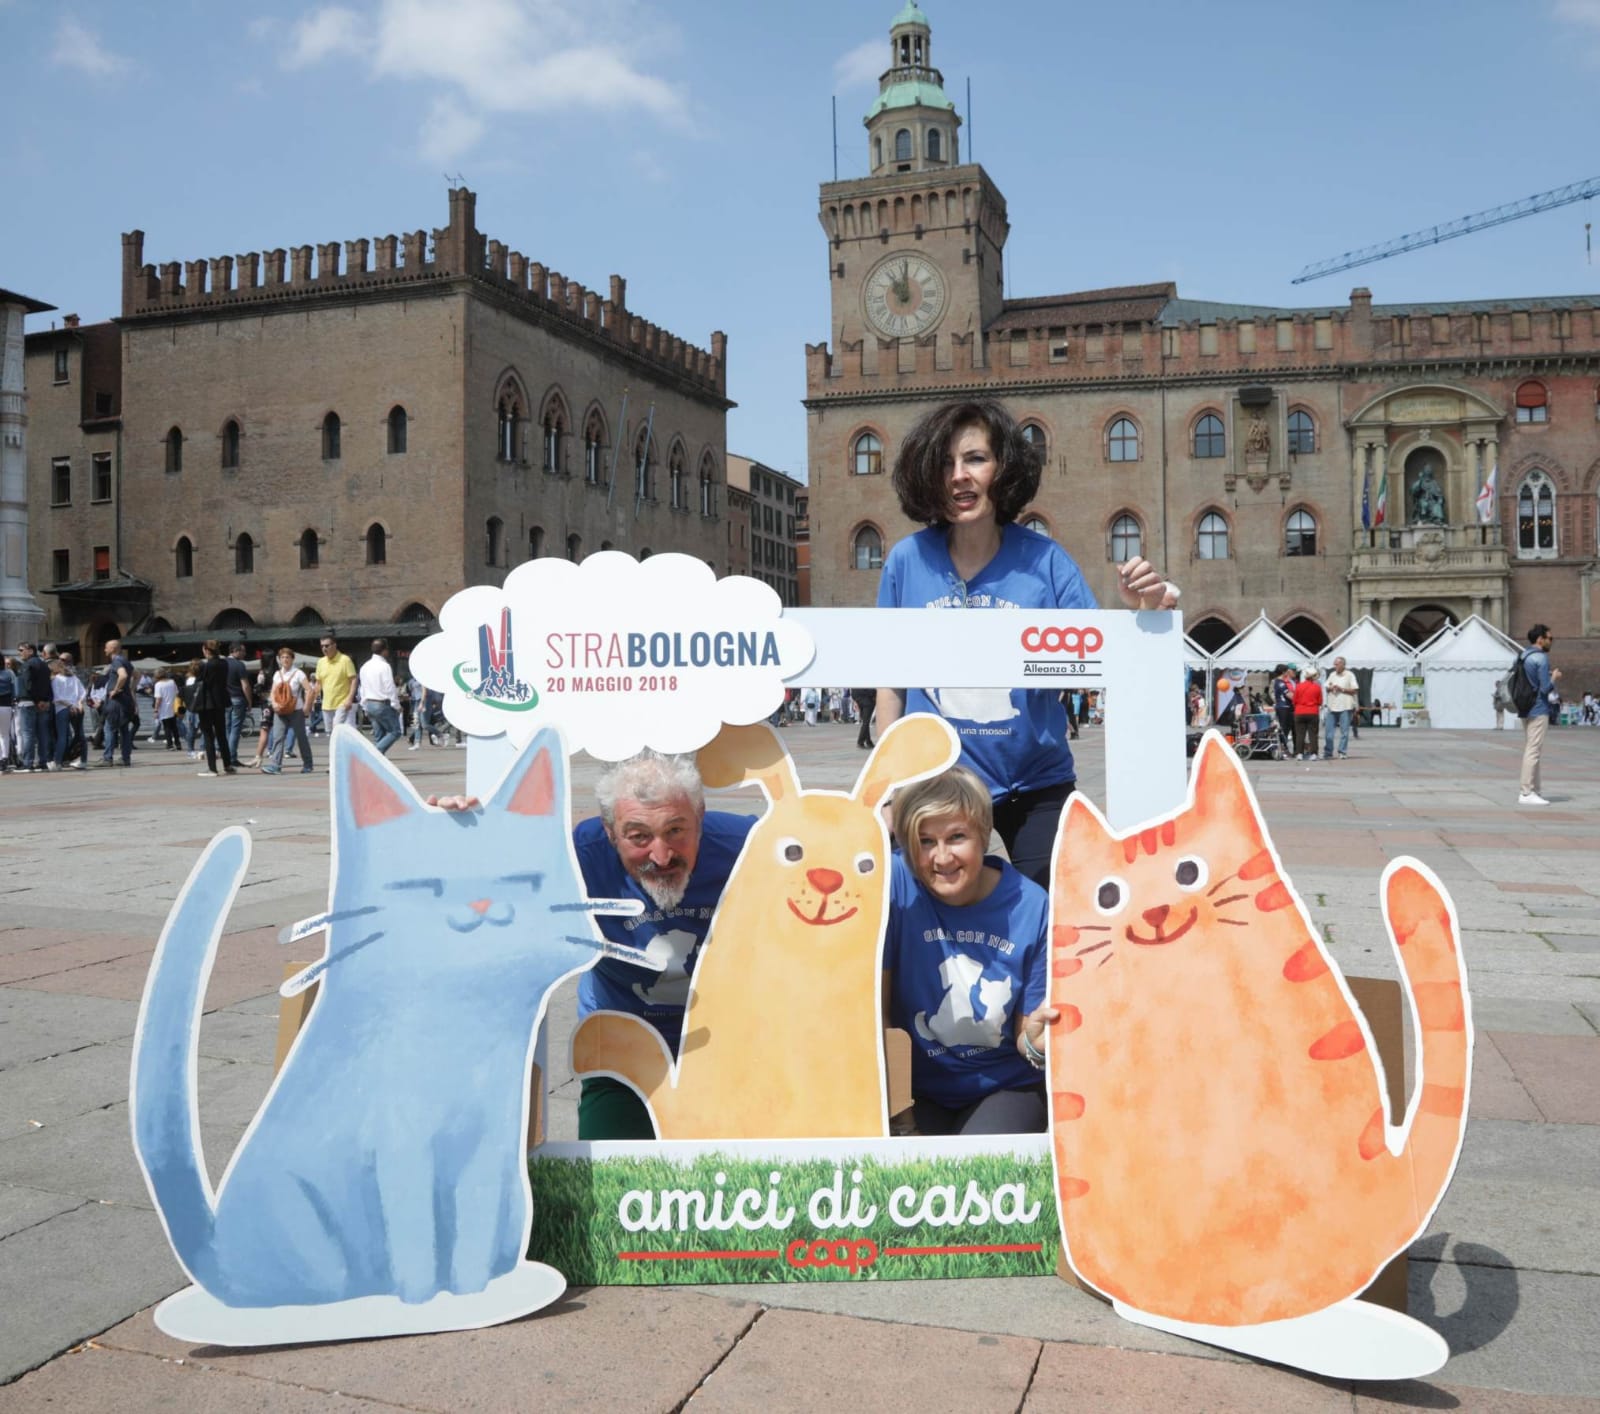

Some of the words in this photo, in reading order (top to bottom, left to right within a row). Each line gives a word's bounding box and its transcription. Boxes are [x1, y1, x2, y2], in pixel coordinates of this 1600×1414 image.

[965, 594, 992, 607] CON
[545, 630, 782, 669] STRABOLOGNA
[1021, 627, 1103, 659] coop
[1023, 664, 1067, 673] Alleanza
[1070, 664, 1086, 673] 3.0
[546, 676, 565, 692] 20
[571, 676, 633, 692] MAGGIO
[639, 675, 678, 692] 2018
[979, 727, 1012, 736] mossa!
[956, 930, 985, 944] CON
[987, 934, 1015, 955] NOI
[617, 1171, 796, 1232] amici
[807, 1169, 878, 1230] di
[888, 1180, 1042, 1228] casa
[786, 1238, 879, 1275] coop
